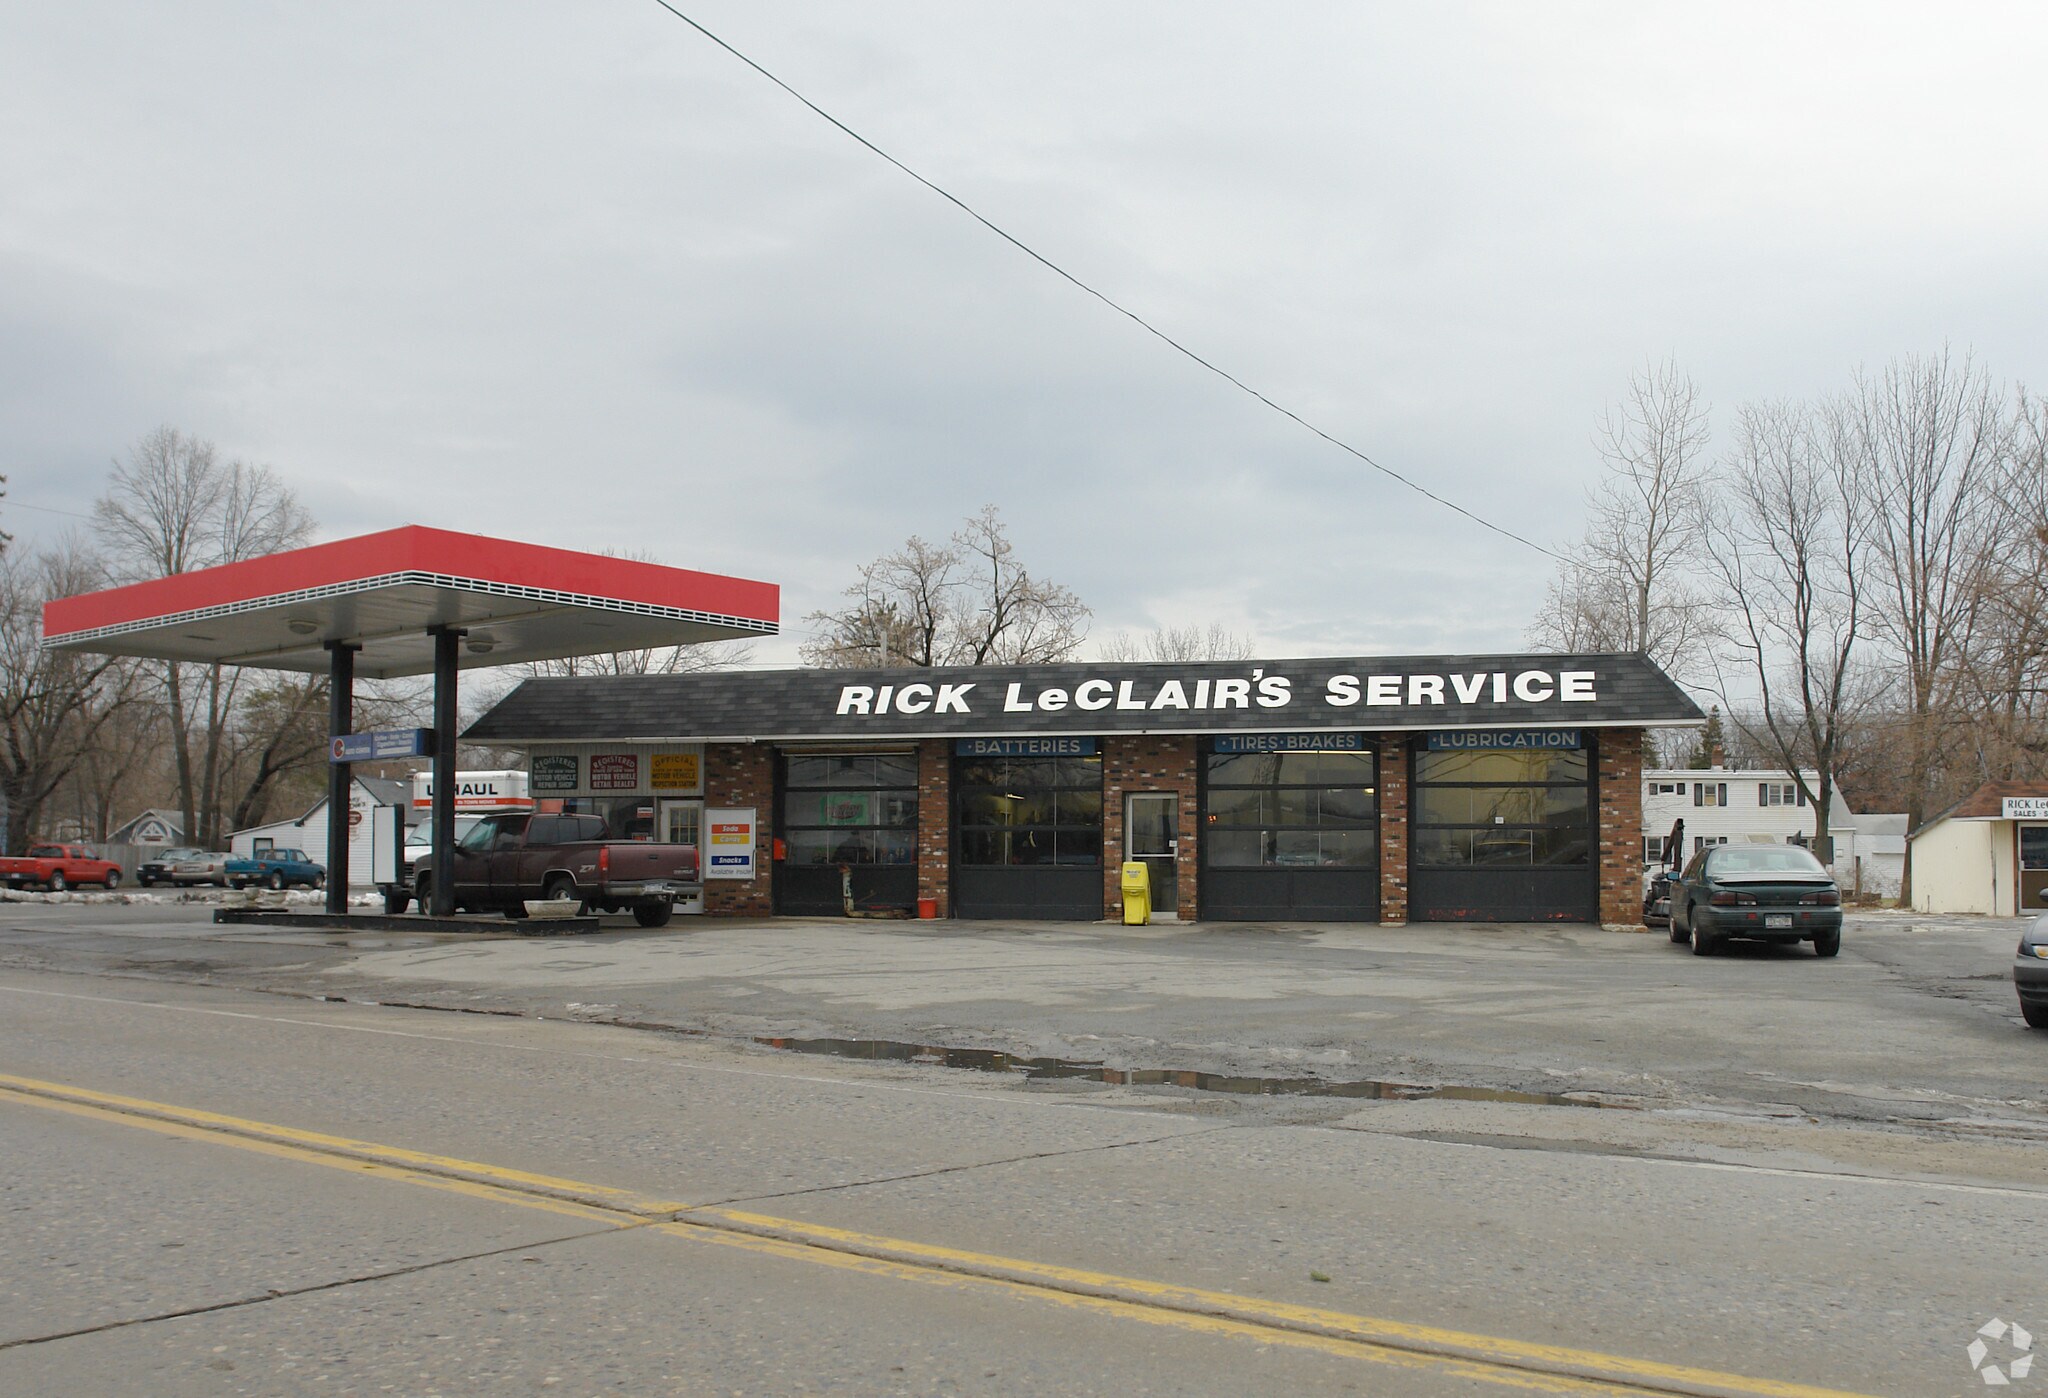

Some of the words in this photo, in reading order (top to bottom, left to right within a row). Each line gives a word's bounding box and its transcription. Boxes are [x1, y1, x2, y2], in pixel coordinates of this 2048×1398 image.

[836, 683, 977, 715] RICK
[1003, 669, 1292, 712] LeCLAIR'S
[1324, 670, 1597, 707] SERVICE
[1439, 731, 1577, 748] LUBRICATION
[974, 738, 1081, 754] BATTERIES
[534, 756, 577, 770] REGISTERED
[592, 755, 636, 769] REGISTERED
[654, 755, 695, 768] OFFICIAL
[533, 774, 553, 782] MOTOR
[552, 773, 577, 782] VEHICLE
[592, 773, 612, 781] MOTOR
[613, 773, 637, 781] VEHICLE
[651, 772, 671, 780] MOTOR
[537, 781, 558, 789] REPAIR
[557, 781, 574, 789] SHOP
[592, 781, 613, 789] RETAIL
[2007, 799, 2032, 809] RICK
[719, 836, 741, 844] Candy
[718, 856, 742, 864] Snacks
